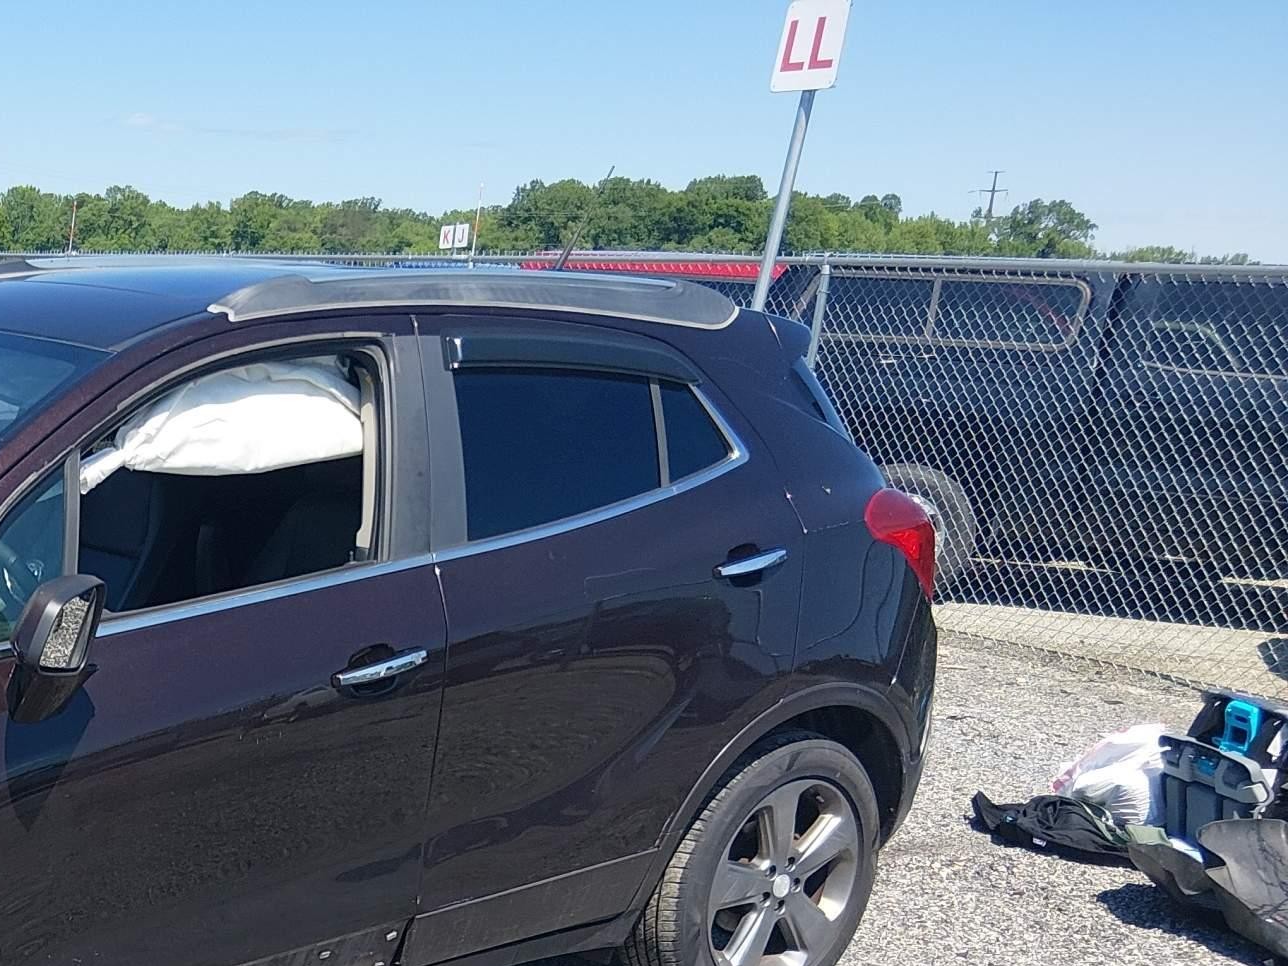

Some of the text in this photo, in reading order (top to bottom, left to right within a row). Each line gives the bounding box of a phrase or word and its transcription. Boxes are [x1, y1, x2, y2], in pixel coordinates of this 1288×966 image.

[779, 16, 833, 72] LL
[443, 229, 451, 245] K
[457, 228, 465, 243] J
